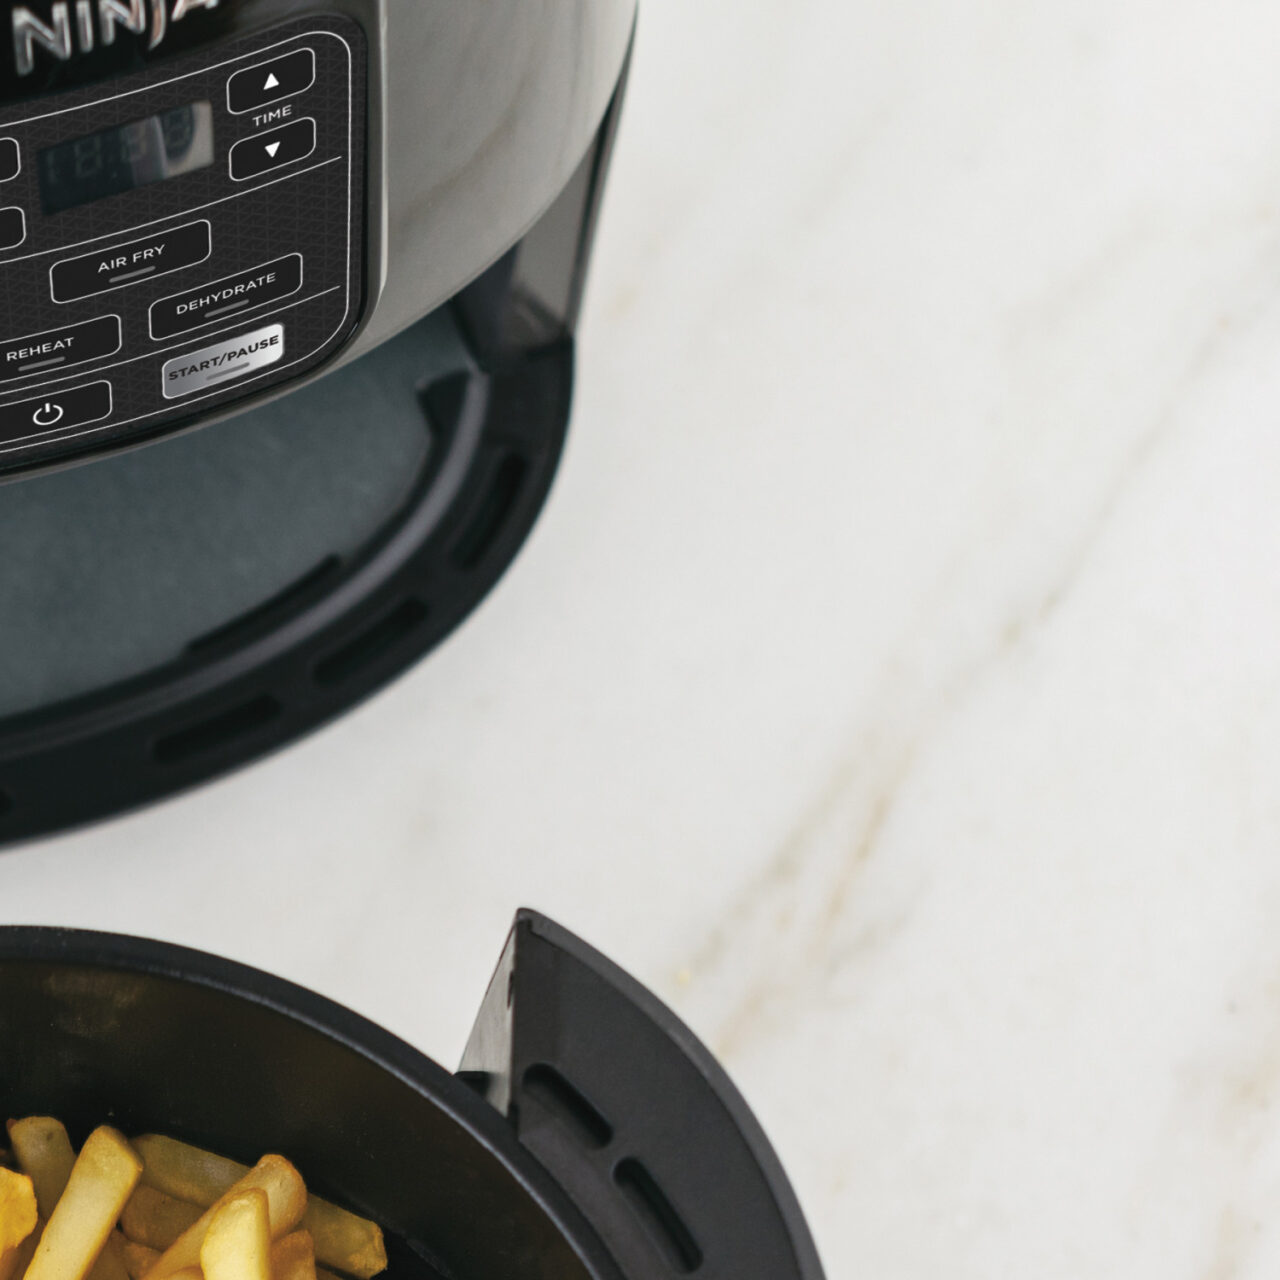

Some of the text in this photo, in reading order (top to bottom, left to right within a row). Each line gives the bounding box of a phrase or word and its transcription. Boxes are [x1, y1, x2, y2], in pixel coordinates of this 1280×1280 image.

[252, 105, 292, 127] TIME
[97, 244, 165, 273] AIR FRY
[176, 272, 276, 315] DEHYDRATE
[6, 336, 74, 361] REHEAT
[168, 334, 280, 381] START/PAUSE
